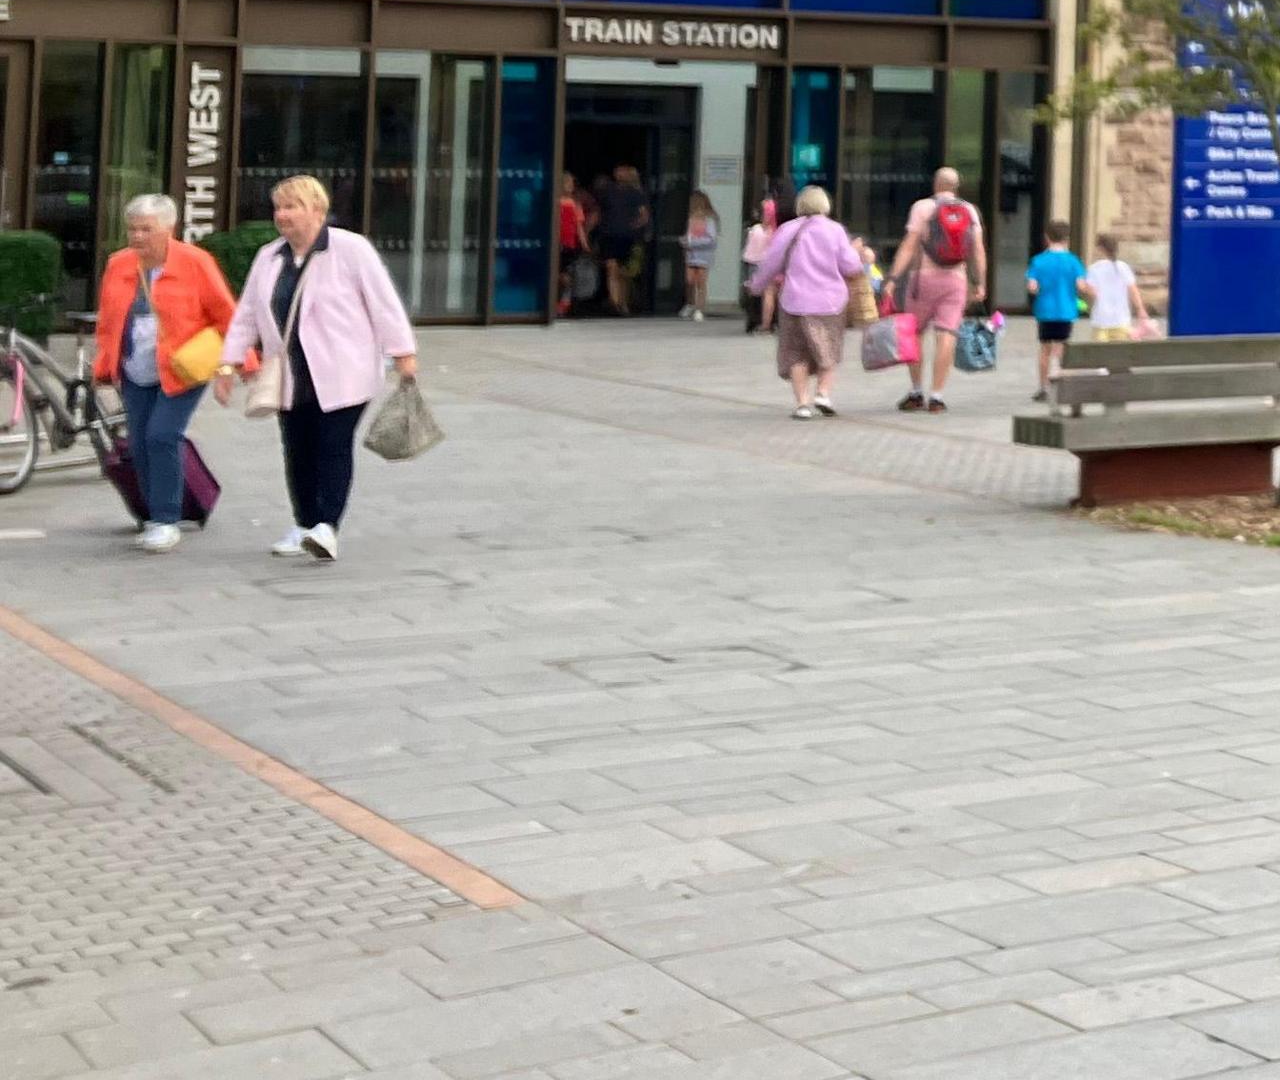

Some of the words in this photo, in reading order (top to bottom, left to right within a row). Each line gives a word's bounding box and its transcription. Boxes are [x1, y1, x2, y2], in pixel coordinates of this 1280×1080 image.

[566, 17, 653, 44] TRAIN
[662, 21, 779, 49] STATION
[186, 61, 221, 167] WEST
